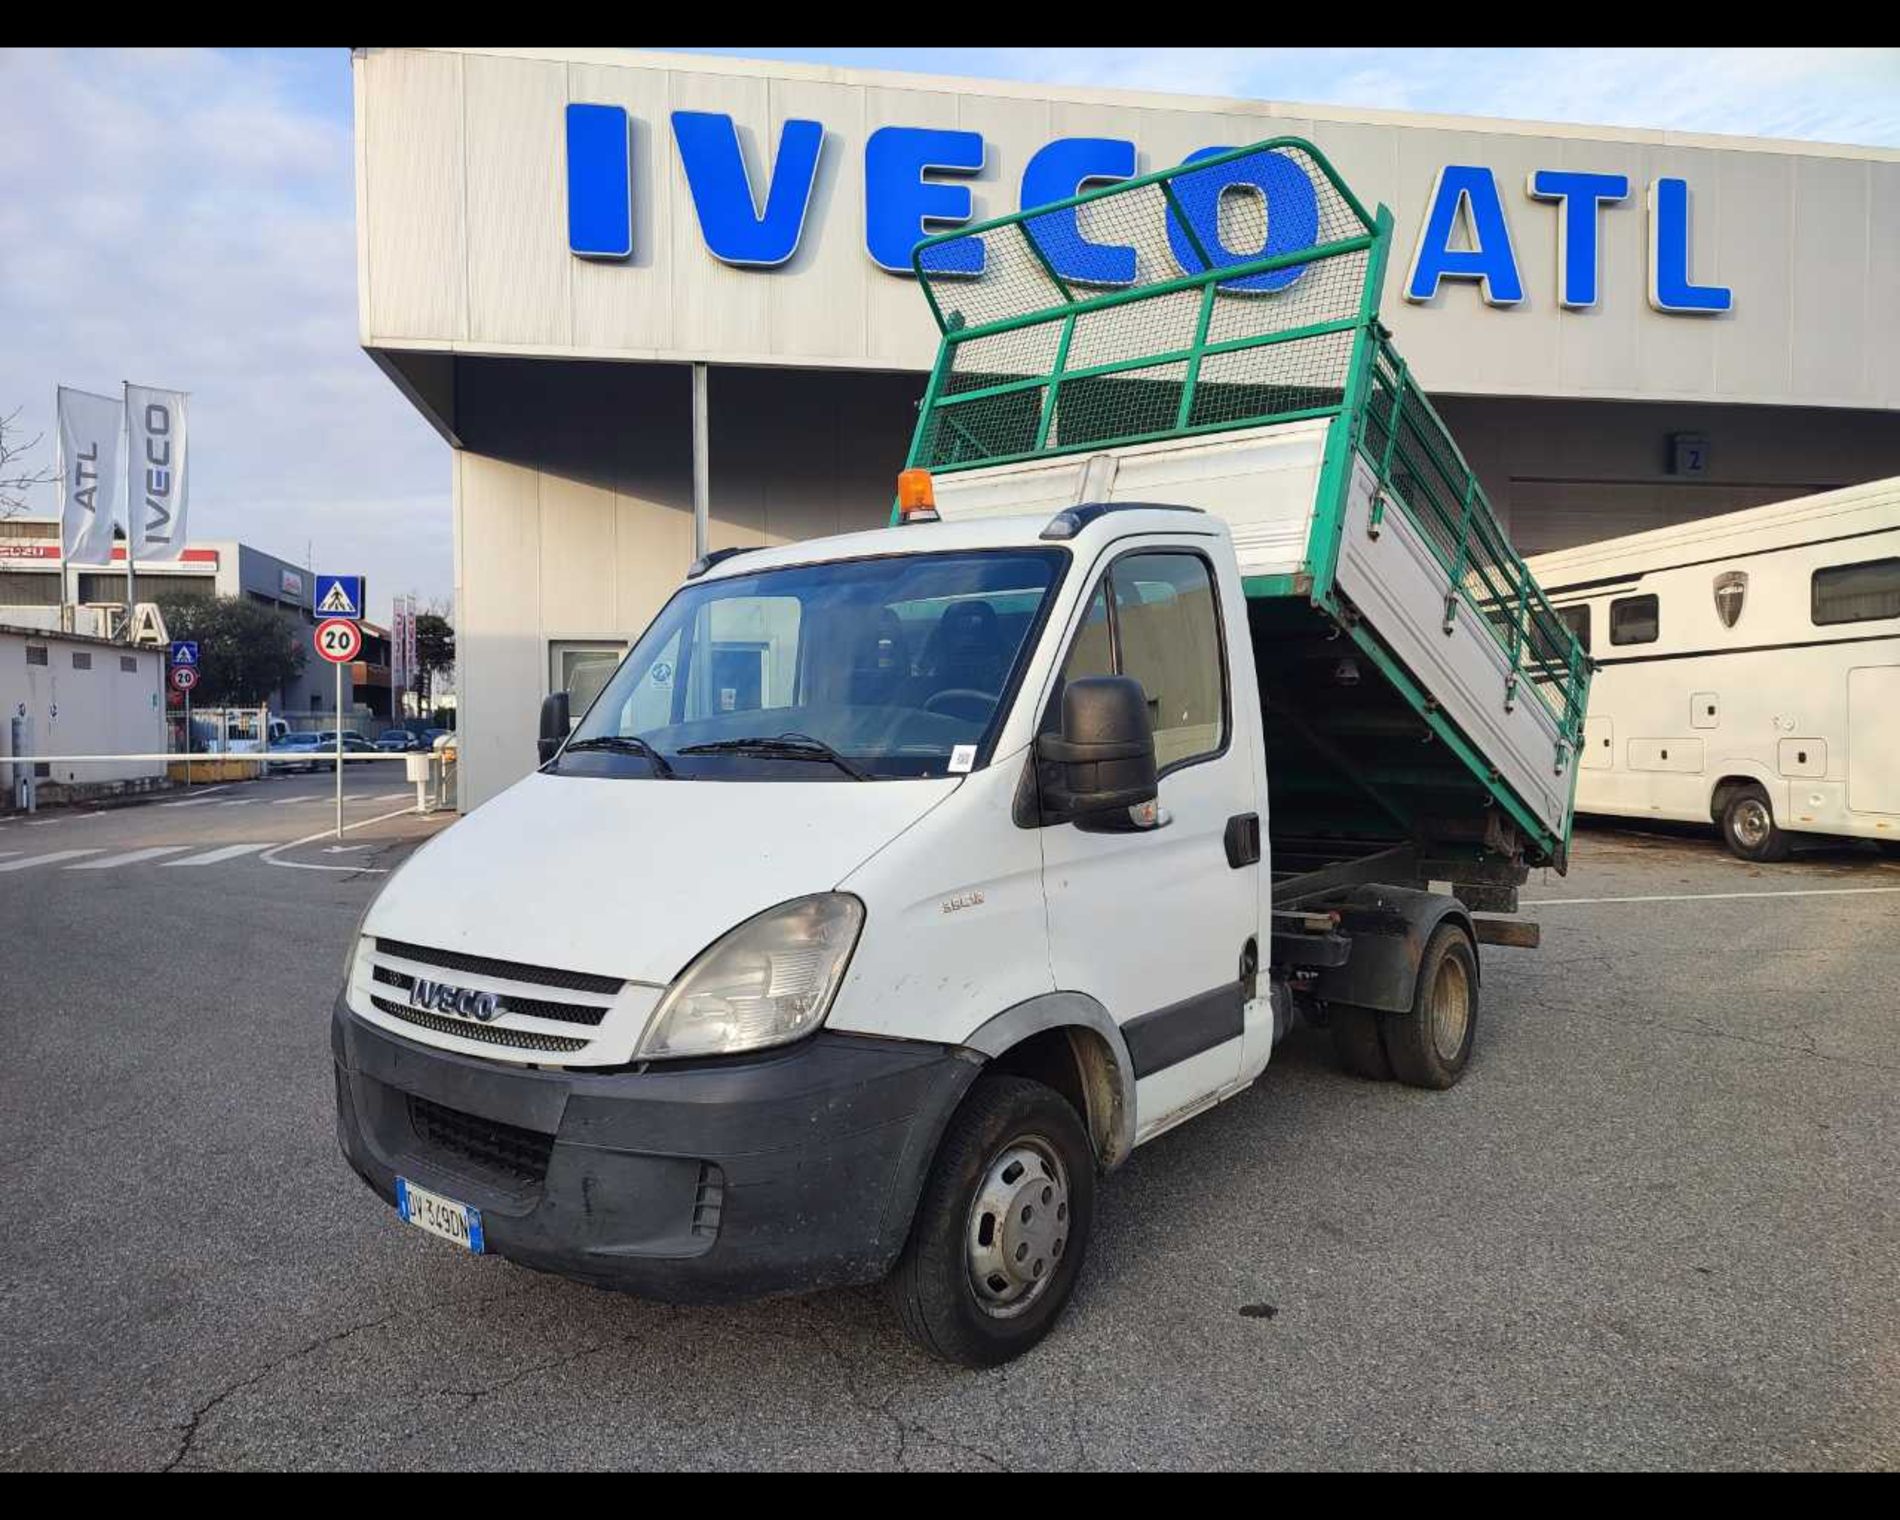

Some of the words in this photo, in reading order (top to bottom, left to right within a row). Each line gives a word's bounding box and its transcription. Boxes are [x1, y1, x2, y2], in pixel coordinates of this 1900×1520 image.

[565, 102, 1320, 295] IVECO
[1404, 165, 1733, 312] ATL
[74, 442, 98, 513] ATL
[145, 404, 170, 544] IVECO
[1688, 450, 1702, 470] 2
[325, 631, 350, 650] 20
[178, 672, 191, 683] 20
[410, 978, 500, 1022] IVECO
